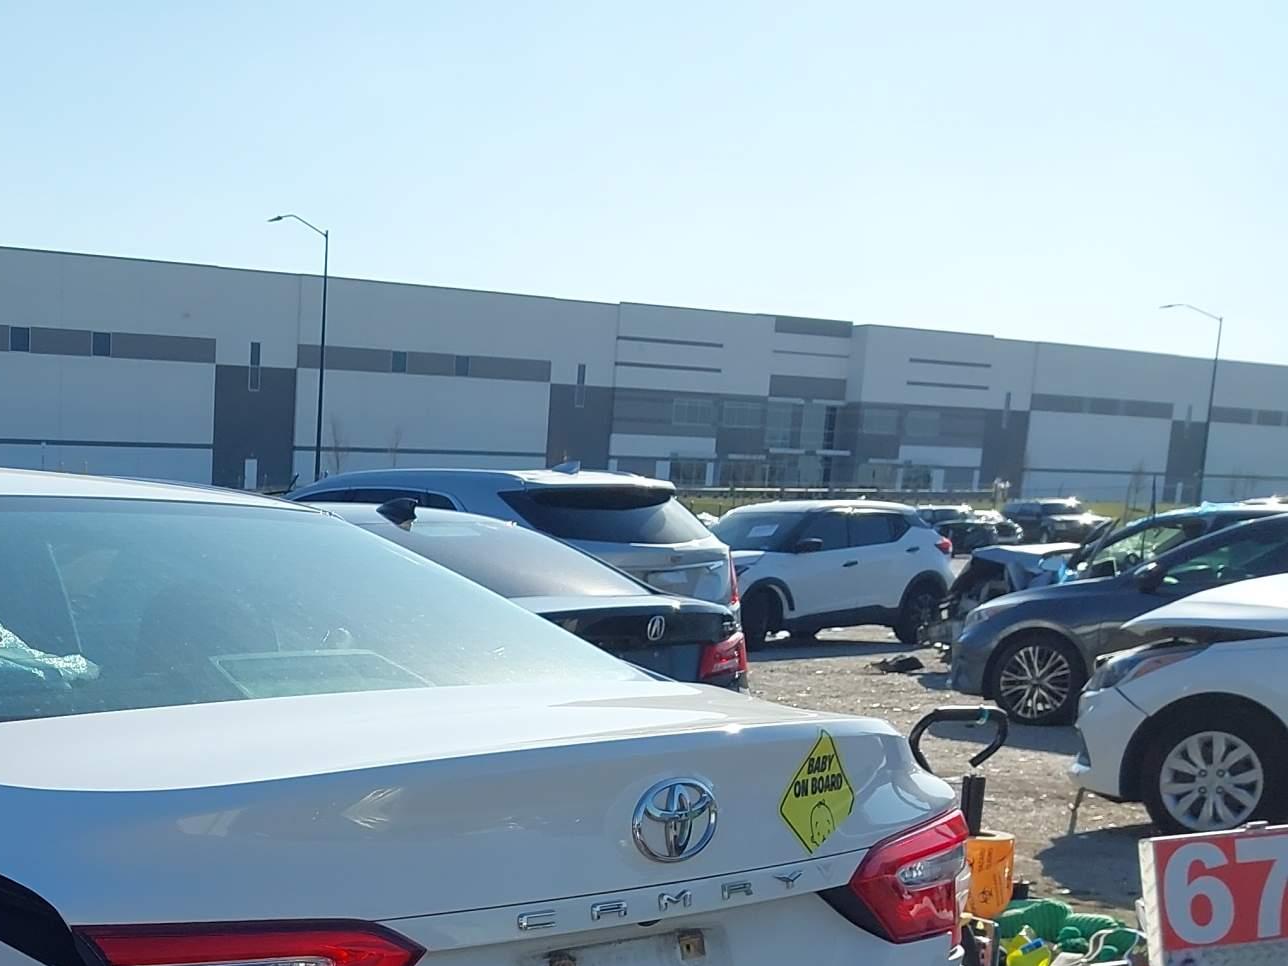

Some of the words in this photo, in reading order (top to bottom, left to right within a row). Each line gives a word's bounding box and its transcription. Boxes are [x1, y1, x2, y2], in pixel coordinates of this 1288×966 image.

[793, 778, 809, 798] ON
[811, 773, 843, 795] BOARD
[807, 754, 835, 775] BABY
[517, 870, 804, 931] CAMRY
[1164, 834, 1288, 945] 67
